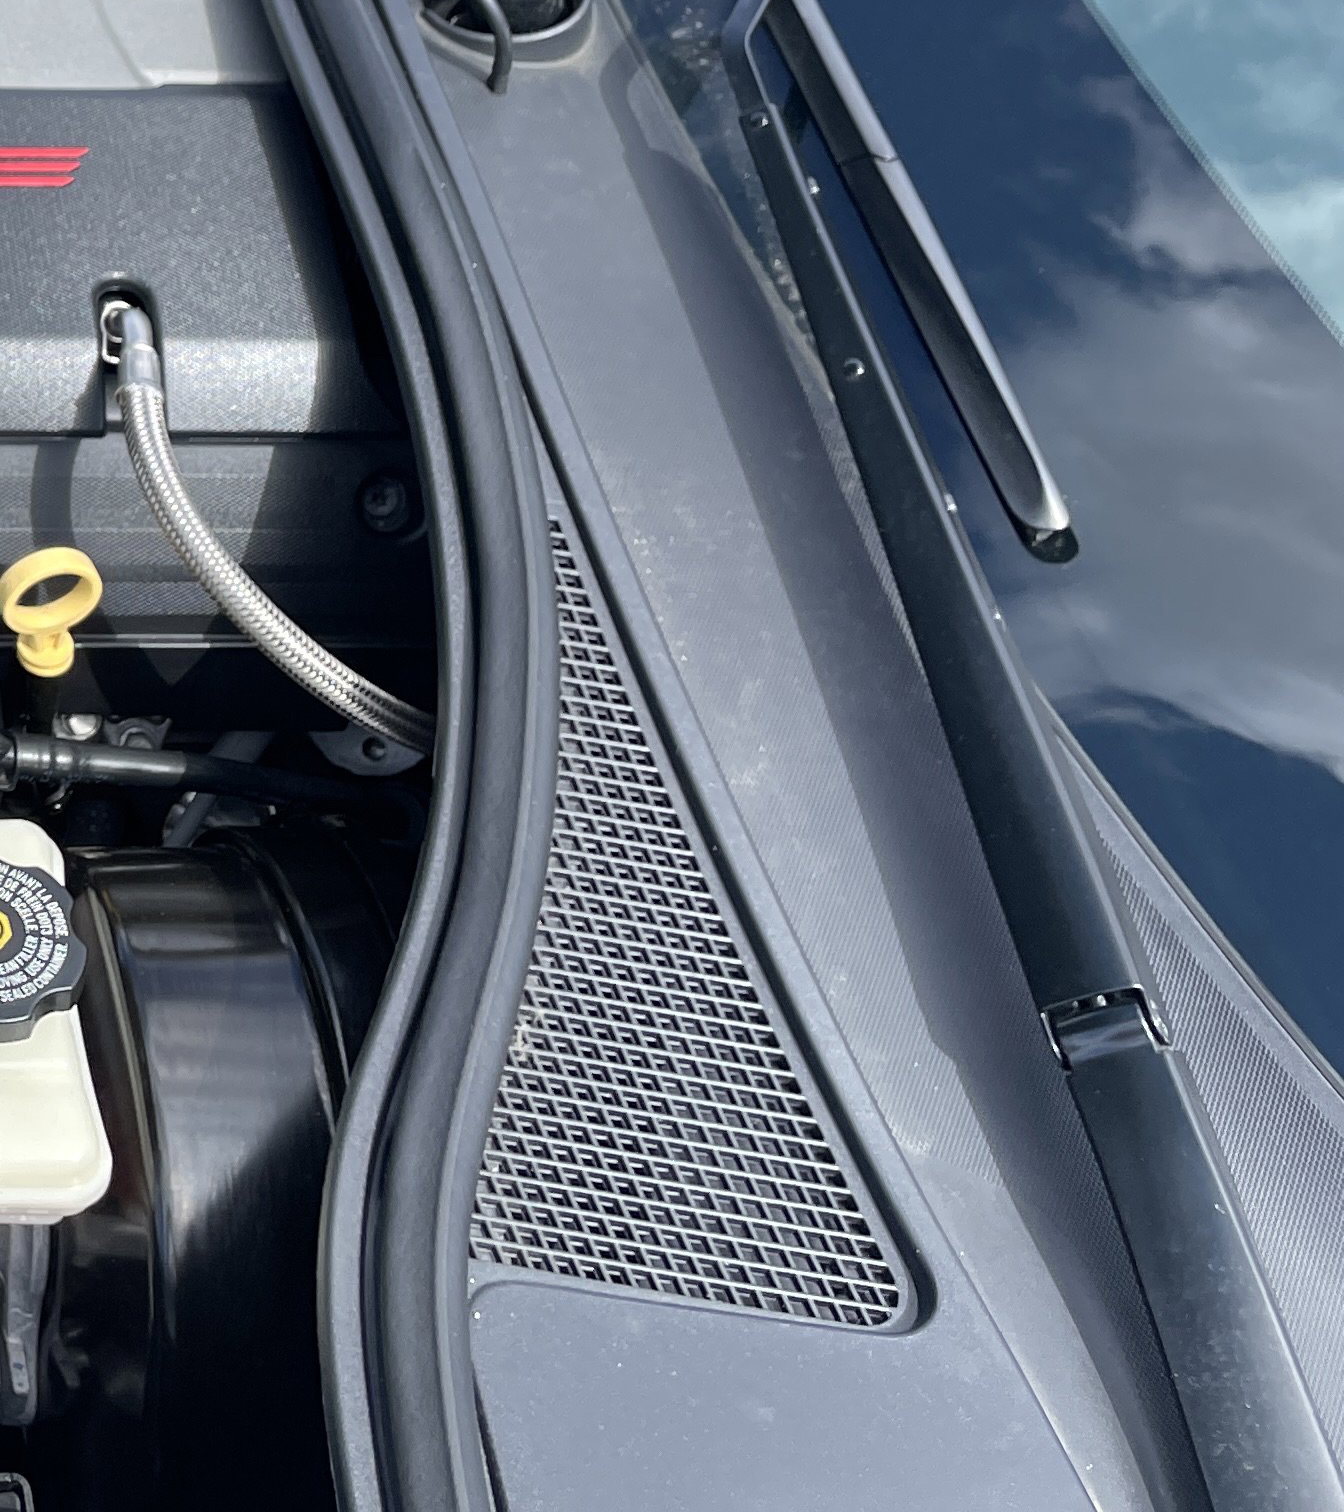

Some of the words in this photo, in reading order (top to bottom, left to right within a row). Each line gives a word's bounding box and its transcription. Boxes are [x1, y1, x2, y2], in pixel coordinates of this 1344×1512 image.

[2, 877, 20, 892] DE
[7, 868, 43, 891] AVANT
[35, 888, 53, 904] LA
[23, 957, 46, 977] USE
